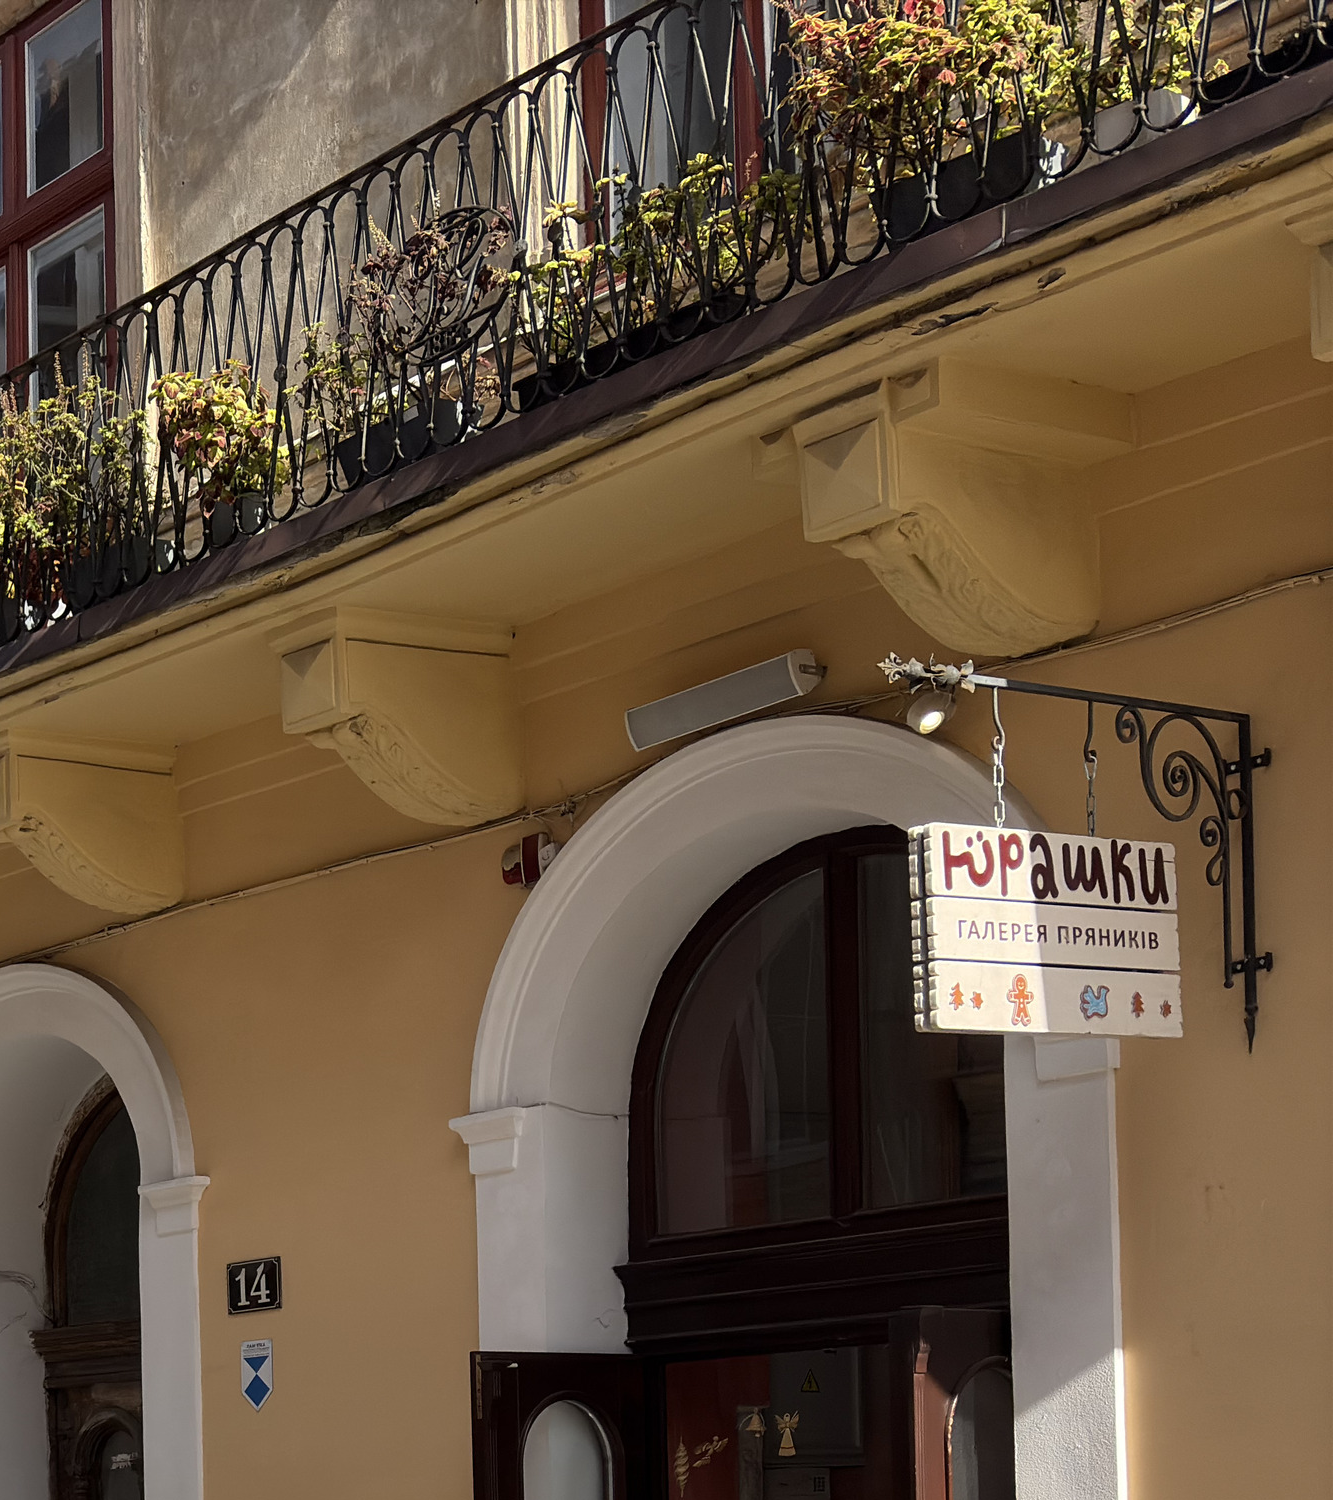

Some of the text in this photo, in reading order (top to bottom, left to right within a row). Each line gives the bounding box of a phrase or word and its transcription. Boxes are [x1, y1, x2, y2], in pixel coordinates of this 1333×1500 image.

[957, 919, 1159, 950] ГАЛЕРЕЯ ПРЯНИКІВ
[234, 1262, 270, 1307] 14
